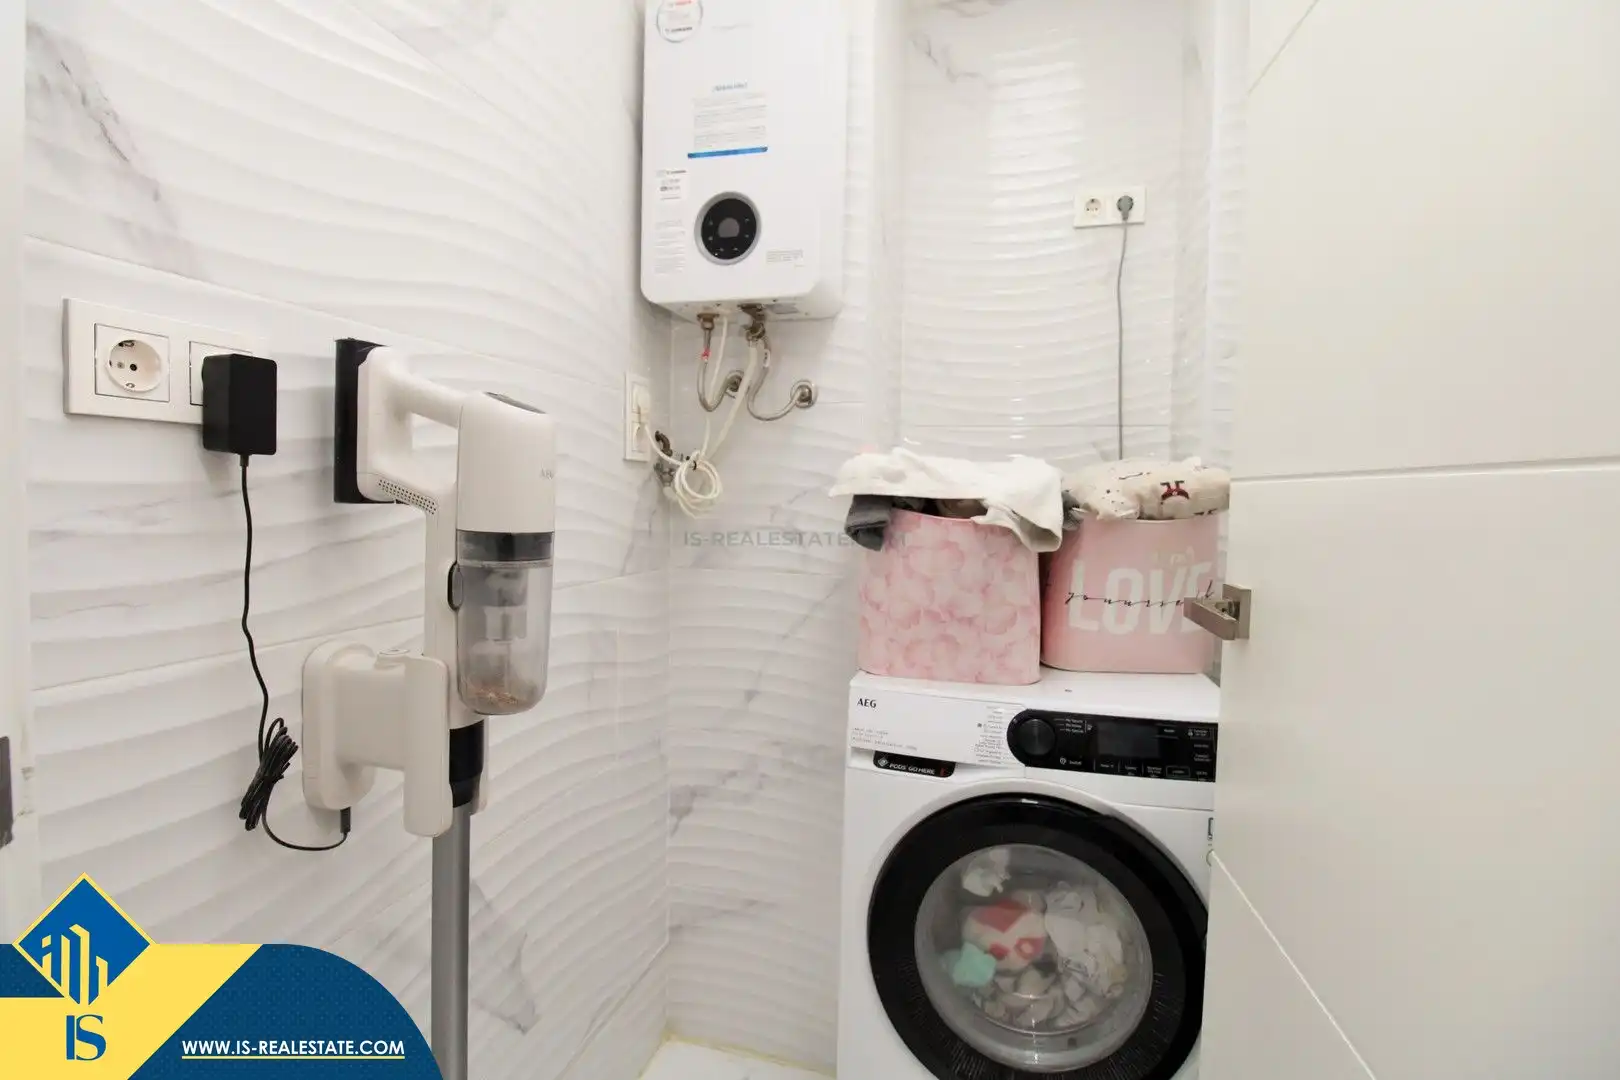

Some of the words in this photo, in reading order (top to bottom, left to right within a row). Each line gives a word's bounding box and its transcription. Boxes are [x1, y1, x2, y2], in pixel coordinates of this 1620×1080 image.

[857, 697, 877, 709] AEG
[889, 762, 907, 771] PODS
[918, 767, 936, 776] HERE
